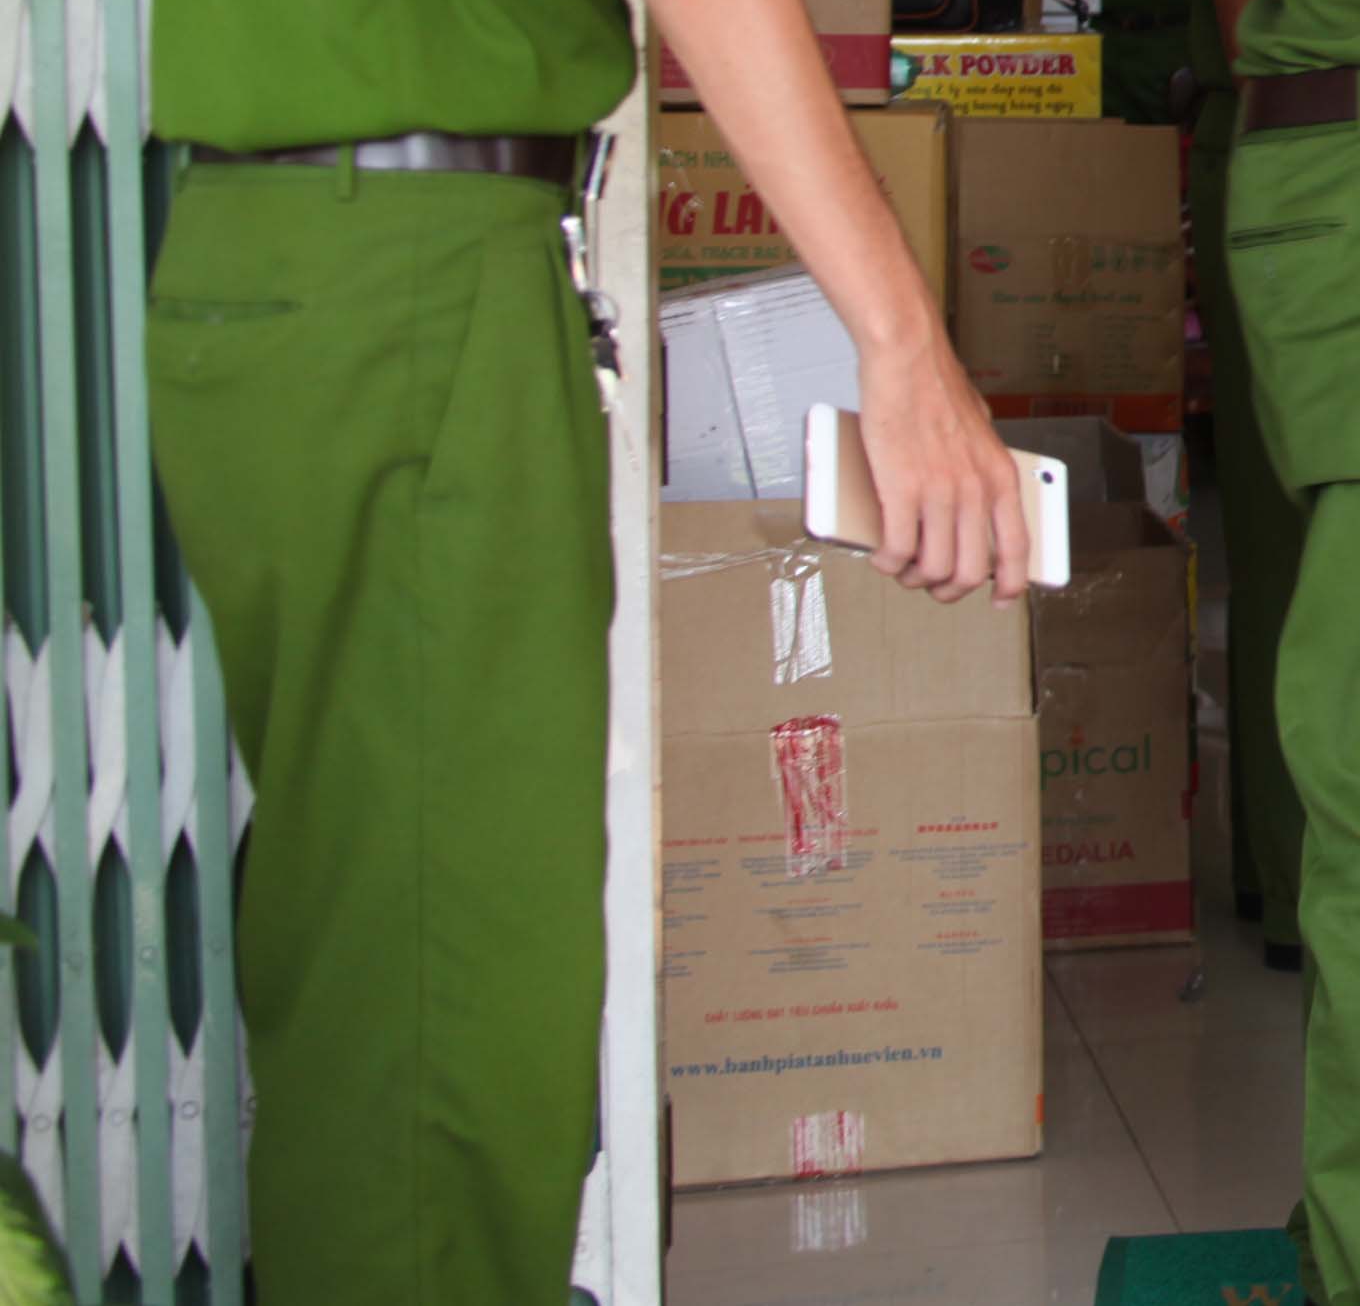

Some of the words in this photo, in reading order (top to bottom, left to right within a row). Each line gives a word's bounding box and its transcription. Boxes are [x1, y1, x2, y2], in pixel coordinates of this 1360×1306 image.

[960, 53, 1077, 76] POWDER
[1042, 734, 1151, 792] pical
[1042, 841, 1135, 866] EDALIA
